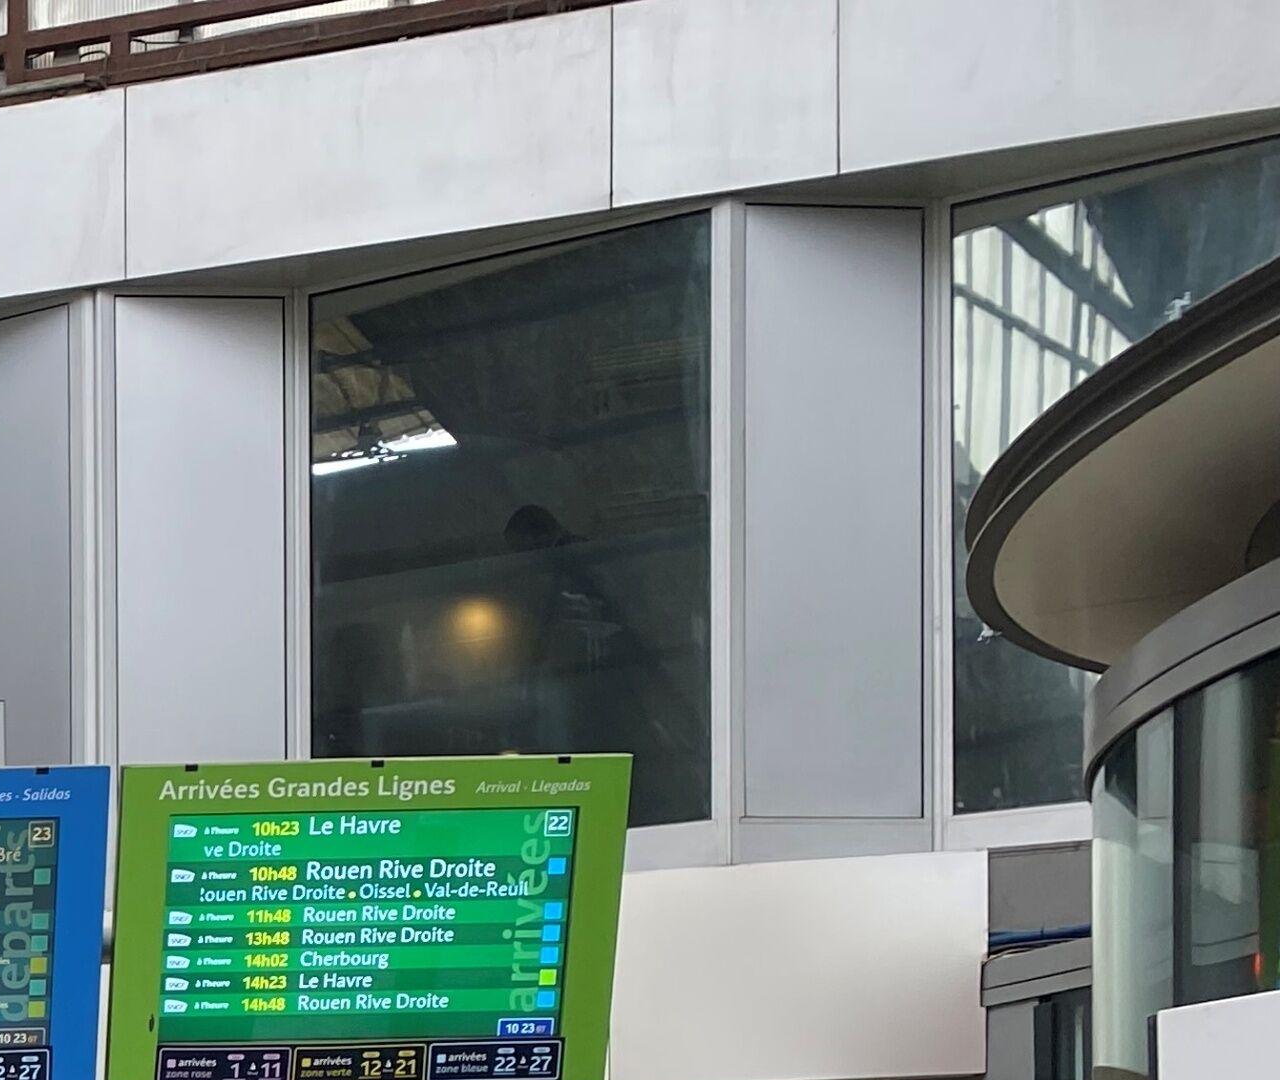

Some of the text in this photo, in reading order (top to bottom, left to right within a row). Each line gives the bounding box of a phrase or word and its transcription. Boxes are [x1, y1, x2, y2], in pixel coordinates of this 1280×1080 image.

[22, 788, 71, 801] Salidas
[159, 776, 591, 800] Arrivées Grandes Lignes Arrival Llegadas
[252, 816, 401, 836] 10h23 Le Havre
[548, 816, 568, 831] 22
[32, 827, 52, 841] 23
[229, 841, 281, 857] Droite
[249, 859, 496, 881] 10h48 Rouen Rive Droite
[252, 886, 288, 901] Rive
[292, 885, 346, 900] Droite
[360, 883, 412, 899] Oissel
[425, 880, 528, 898] Val-de-Reuil
[247, 905, 456, 923] 11h48 Rouen Rive Droite
[246, 928, 454, 945] 13h48 Rouen Rive Droite
[244, 951, 389, 969] 14h02 Cherbourg
[243, 973, 373, 989] 14h23 Le Havre
[242, 993, 449, 1012] 14h48 Rouen Rive Droite
[178, 1058, 216, 1067] arrivées
[313, 1057, 352, 1066] arrivées
[448, 1053, 487, 1062] arrivées
[494, 1057, 516, 1072] 22
[529, 1056, 552, 1071] 27
[19, 1065, 41, 1080] 27
[261, 1062, 280, 1078] 11
[361, 1061, 381, 1076] 12
[394, 1059, 416, 1075] 21
